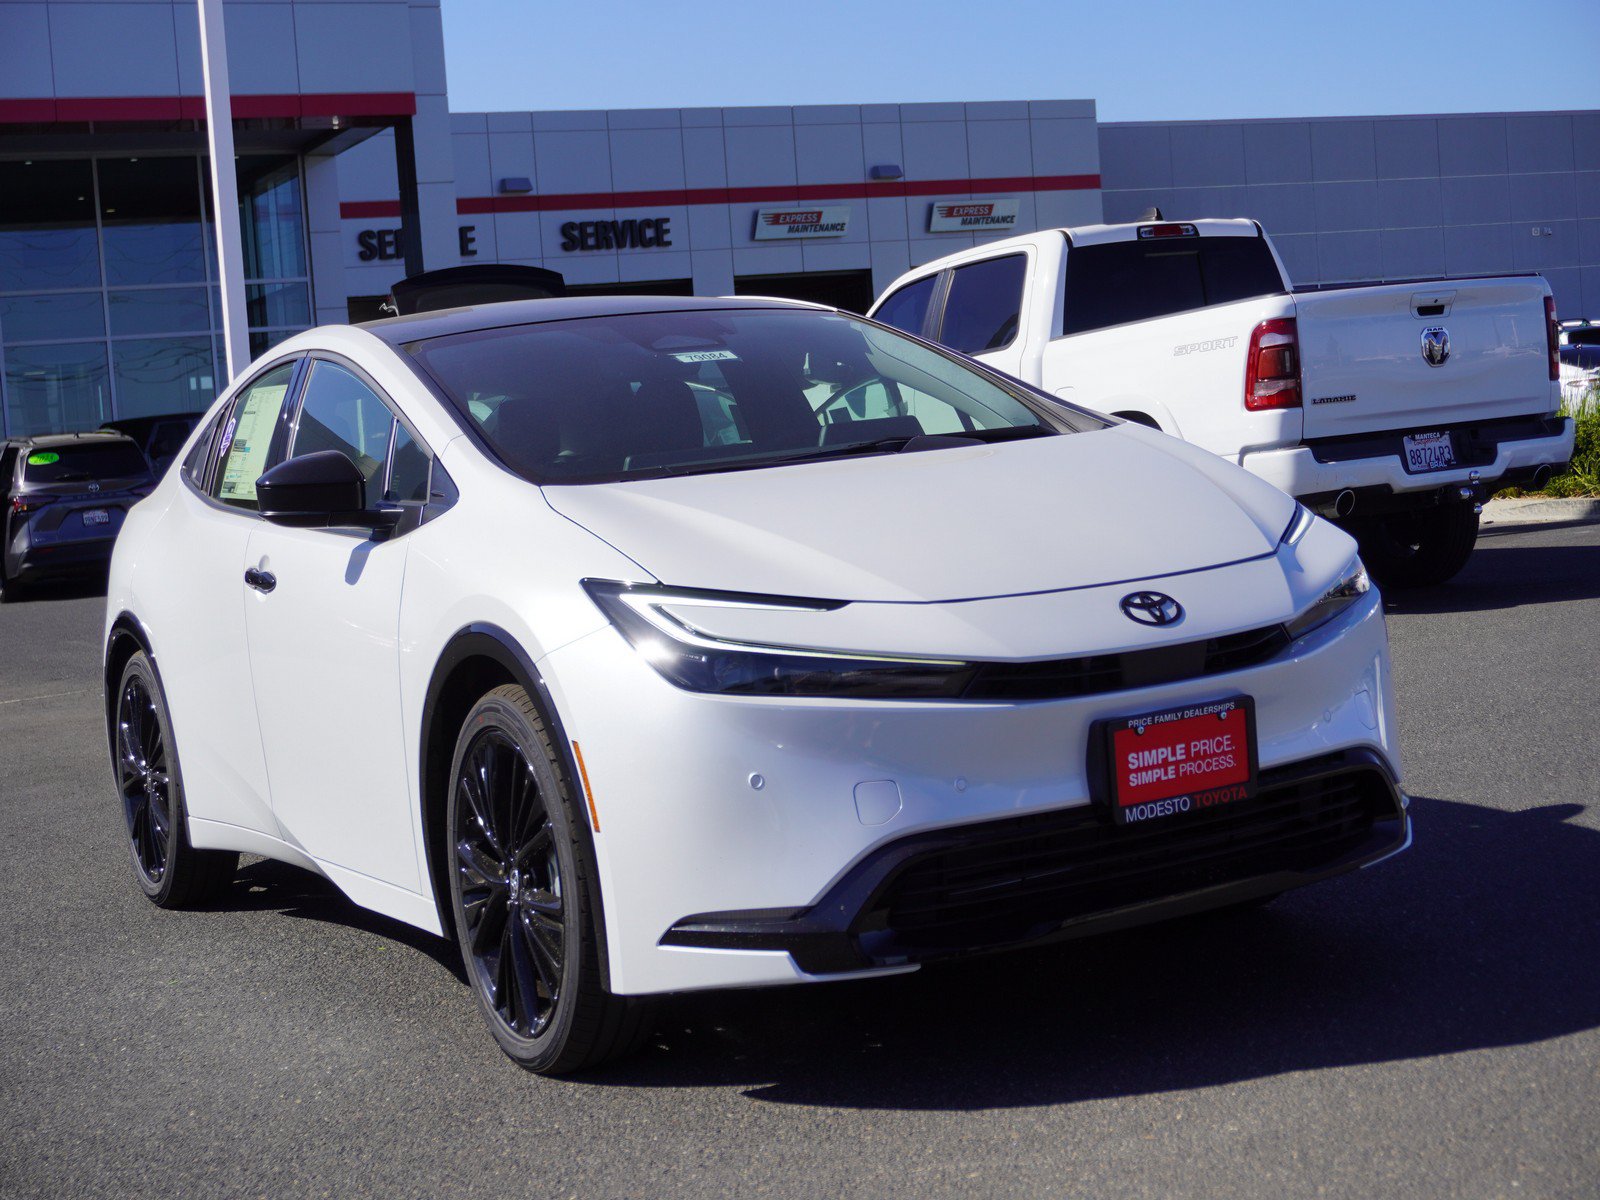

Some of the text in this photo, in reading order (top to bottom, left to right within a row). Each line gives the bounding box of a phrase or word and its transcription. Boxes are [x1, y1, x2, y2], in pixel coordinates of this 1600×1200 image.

[779, 212, 818, 224] EXPRESS
[954, 205, 990, 217] EXPRESS
[787, 222, 846, 234] MAINTENANCE
[960, 215, 1015, 226] MAINTENANCE
[561, 217, 672, 251] SERVICE
[1173, 336, 1239, 357] SPORT
[685, 352, 728, 362] 79084
[1312, 394, 1357, 405] LARAMIE
[1414, 432, 1441, 440] MANTECA
[1409, 445, 1452, 465] 88724R3
[1128, 702, 1235, 728] PRICE FAMILY DEALERSHIPS
[1127, 735, 1236, 770] SIMPLE PRICE.
[1128, 755, 1237, 787] SIMPLE PROCESS.
[1125, 786, 1248, 824] MODESTO TOYOTA
